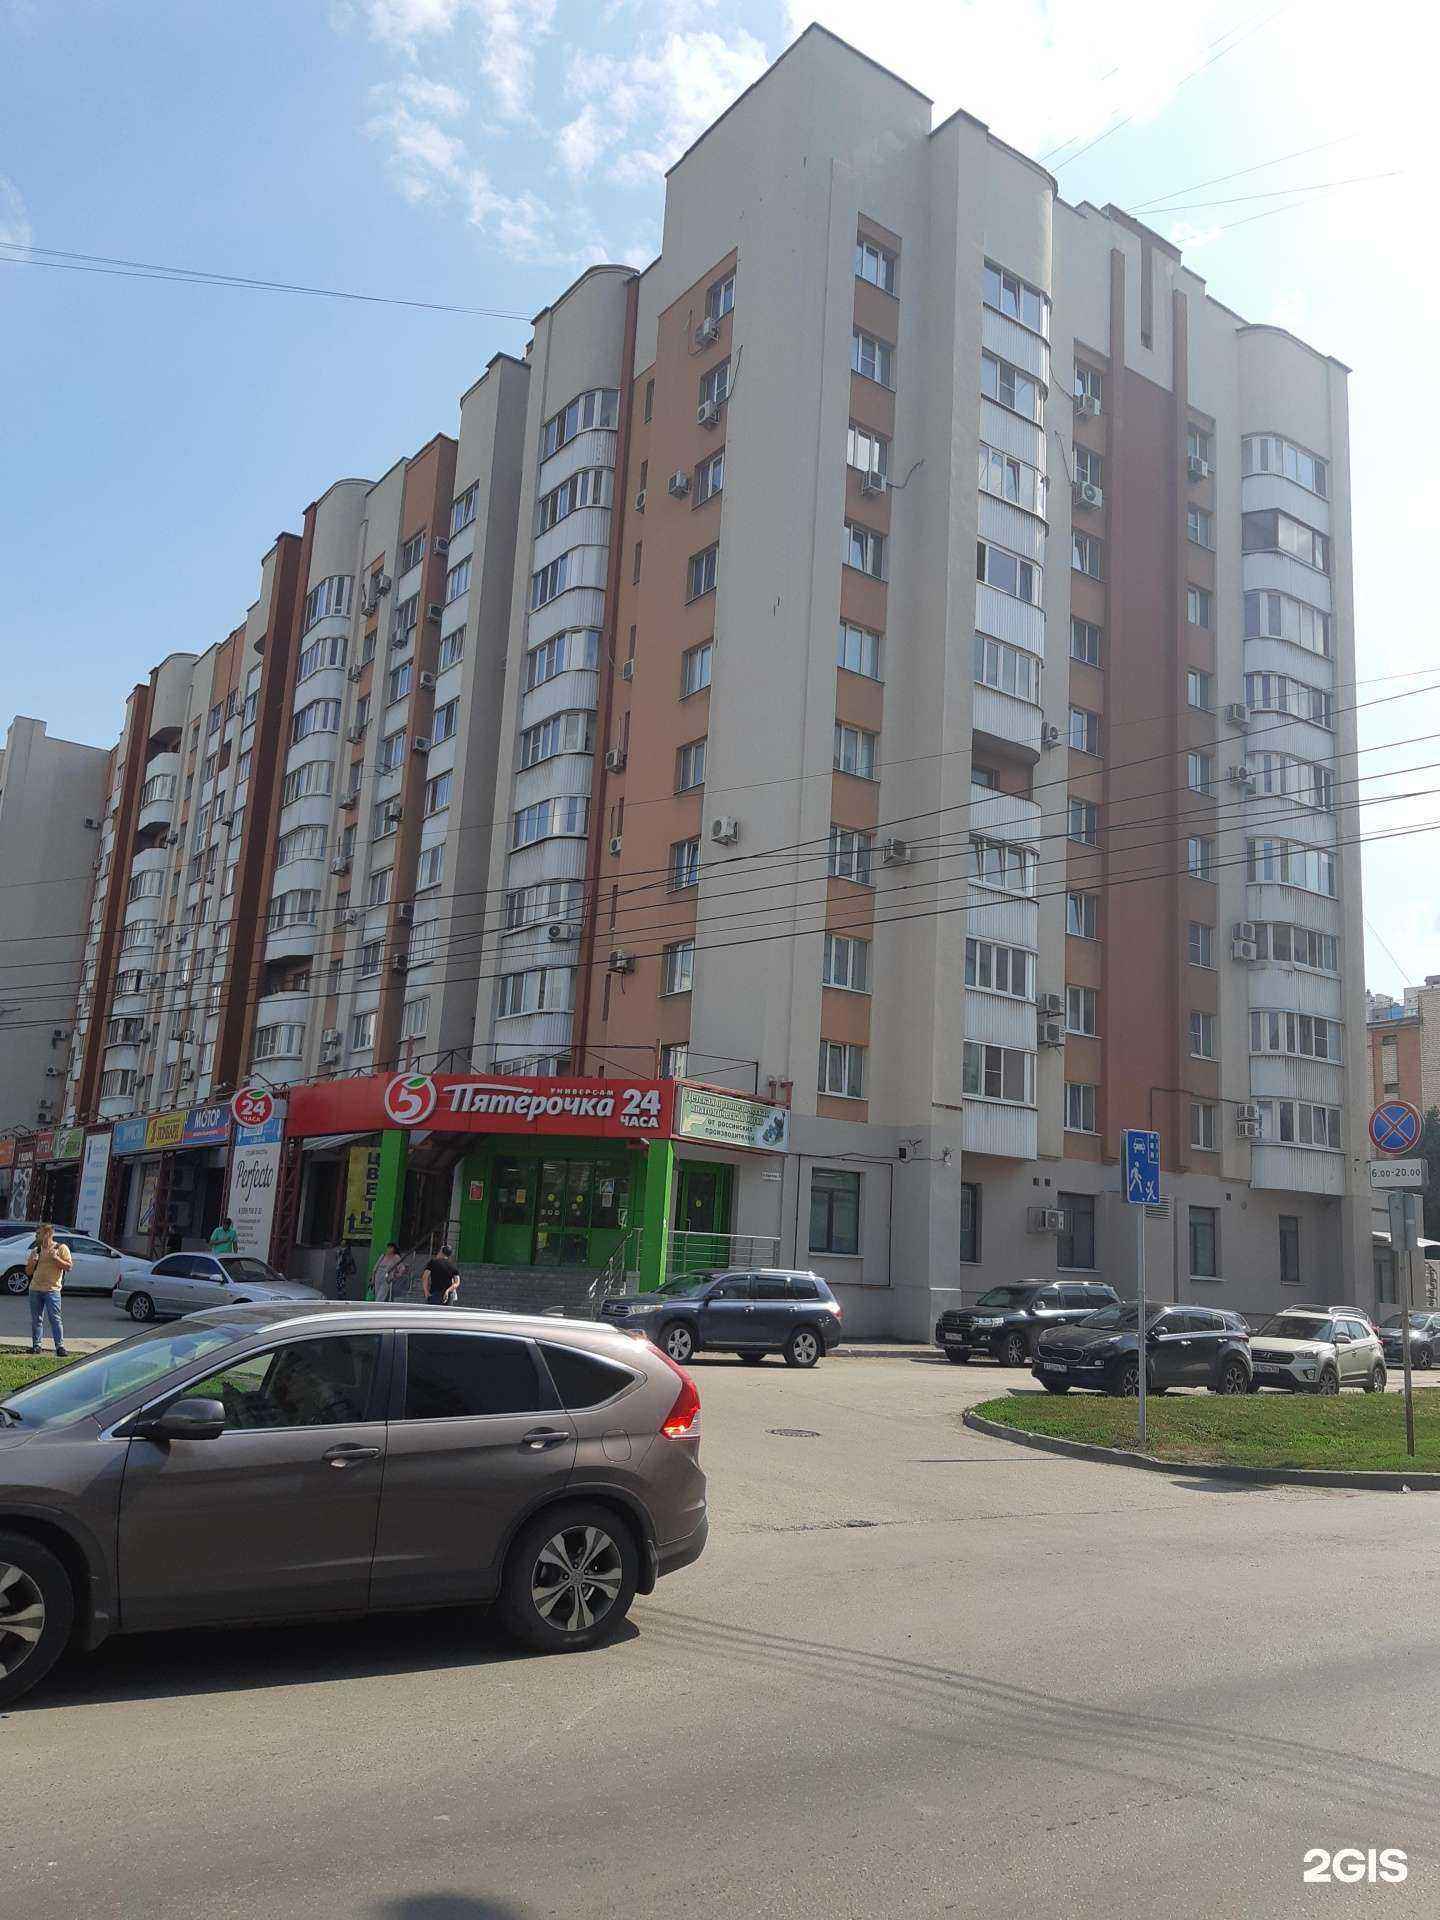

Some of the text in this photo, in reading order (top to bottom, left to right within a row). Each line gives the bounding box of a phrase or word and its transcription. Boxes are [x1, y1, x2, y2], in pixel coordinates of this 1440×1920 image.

[550, 1087, 614, 1096] УНИВЕРСАМ
[241, 1099, 266, 1116] 24
[622, 1088, 661, 1116] 24
[194, 1108, 221, 1128] МОТОР
[620, 1115, 659, 1128] ЧАСА
[236, 1159, 274, 1202] Perfecto
